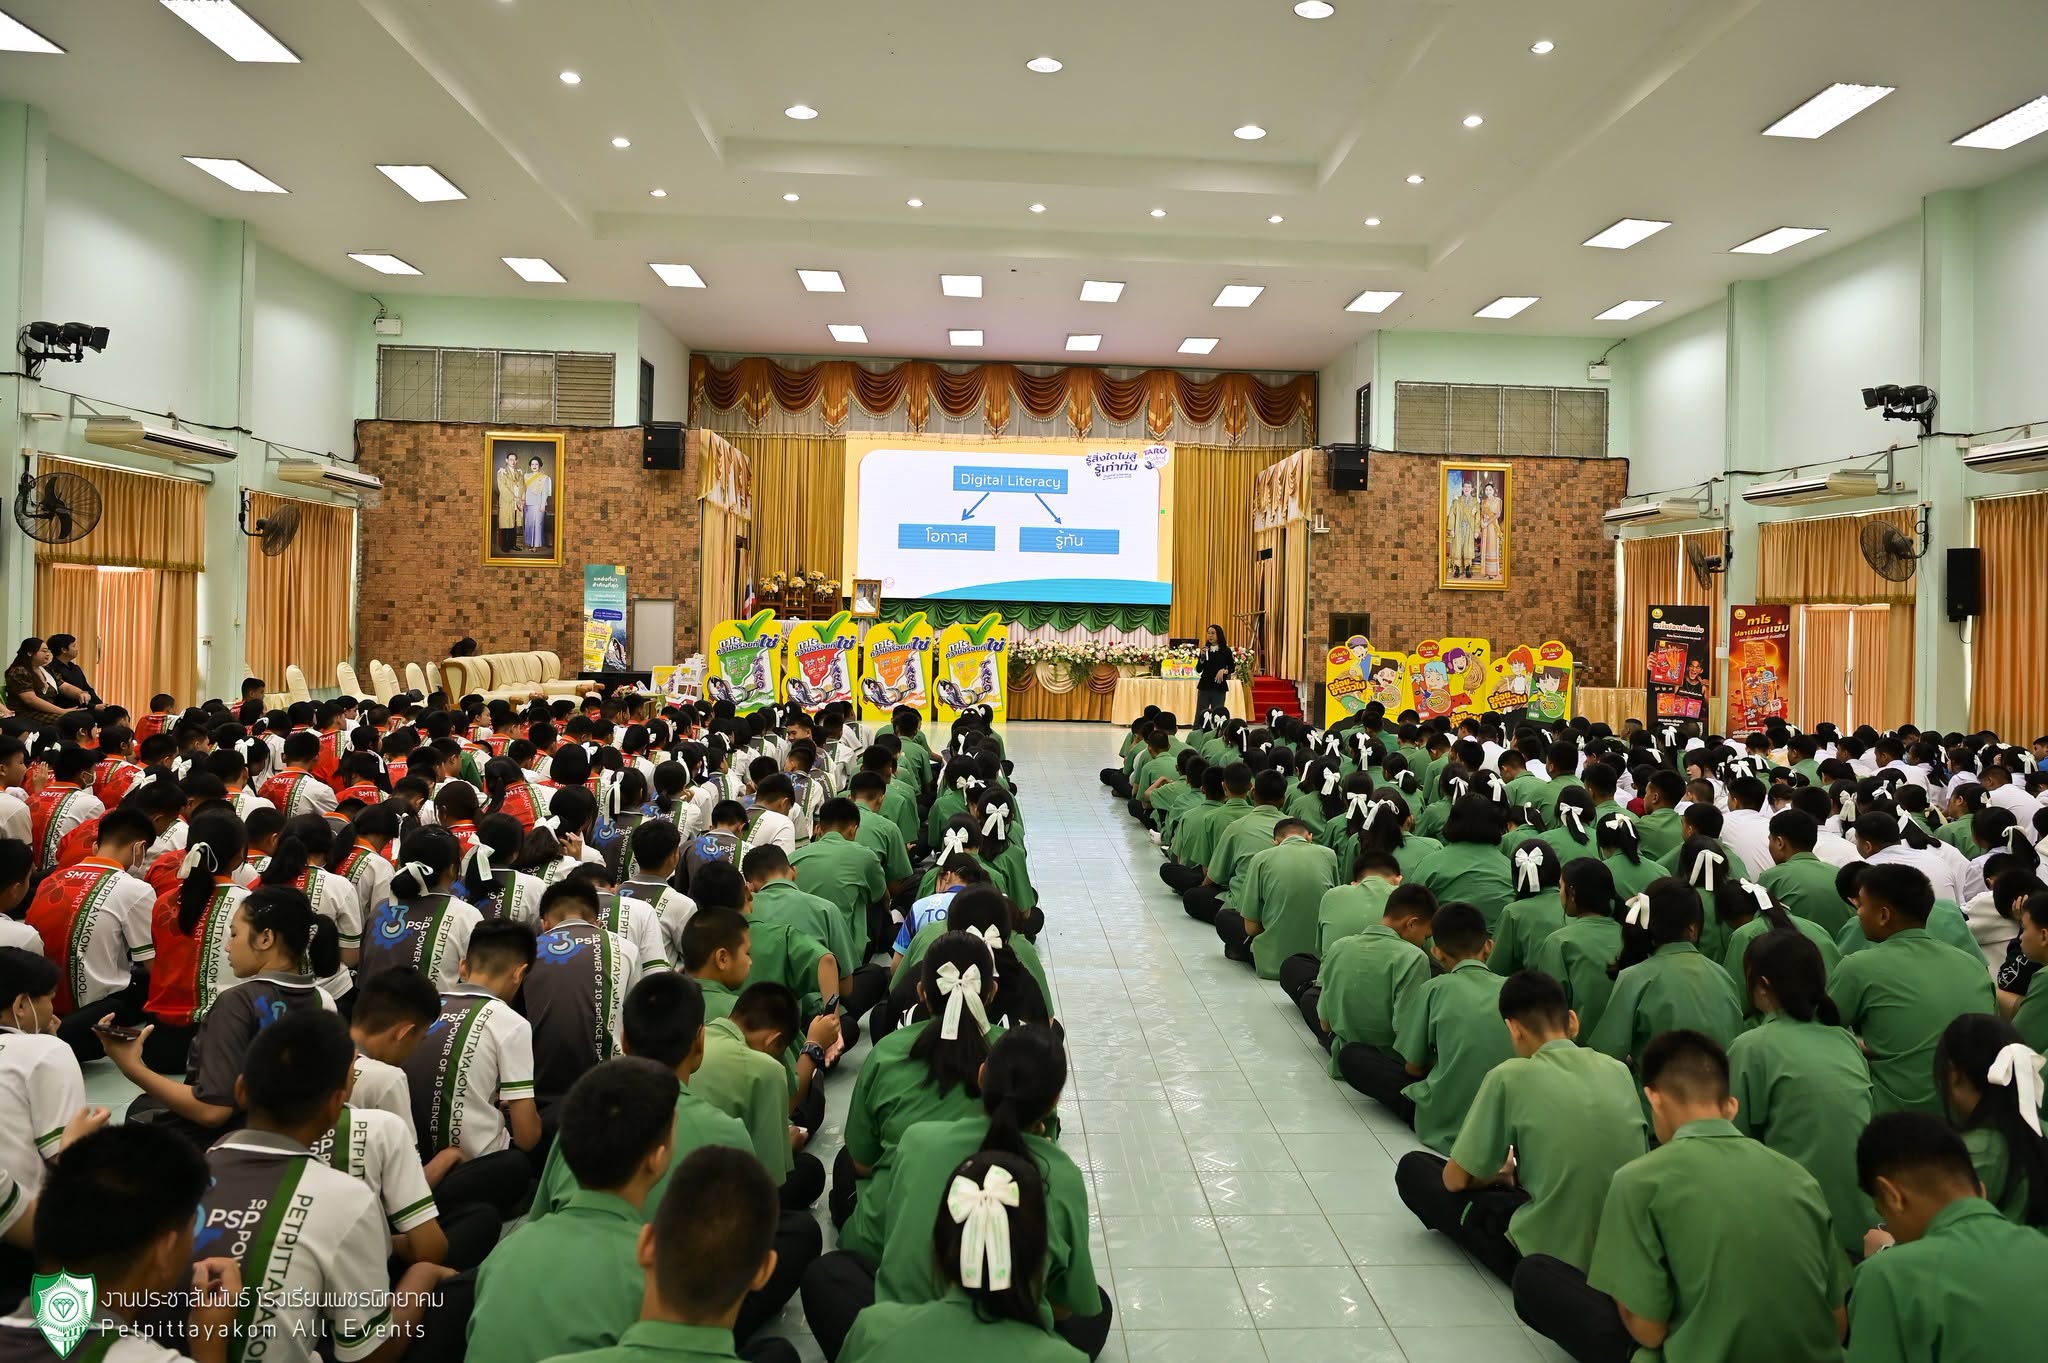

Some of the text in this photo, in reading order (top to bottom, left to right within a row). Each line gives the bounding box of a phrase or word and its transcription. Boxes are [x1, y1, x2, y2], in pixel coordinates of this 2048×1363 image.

[1094, 461, 1138, 477] รู้เท่าทัน
[961, 473, 1061, 490] Digital Literacy
[926, 527, 968, 543] โอกาส
[1055, 529, 1083, 550] รู้ทัน
[1747, 614, 1771, 626] ทาโร
[64, 870, 102, 880] SMTE
[72, 880, 95, 910] SMART
[405, 920, 430, 931] PSP
[77, 876, 121, 995] PETPITTAYAKOM SCHOOL
[207, 896, 235, 984] PETPITTAYAKOM
[413, 930, 427, 963] POWER
[593, 943, 603, 972] POWER
[594, 974, 603, 987] OF
[440, 1013, 466, 1023] PSP
[443, 1022, 461, 1056] POWER
[456, 1007, 494, 1097] PETPITTAYAKOM
[438, 1058, 448, 1073] OF
[435, 1076, 445, 1087] 10
[430, 1090, 442, 1132] SCIENCE
[206, 1199, 268, 1230] PSP 10
